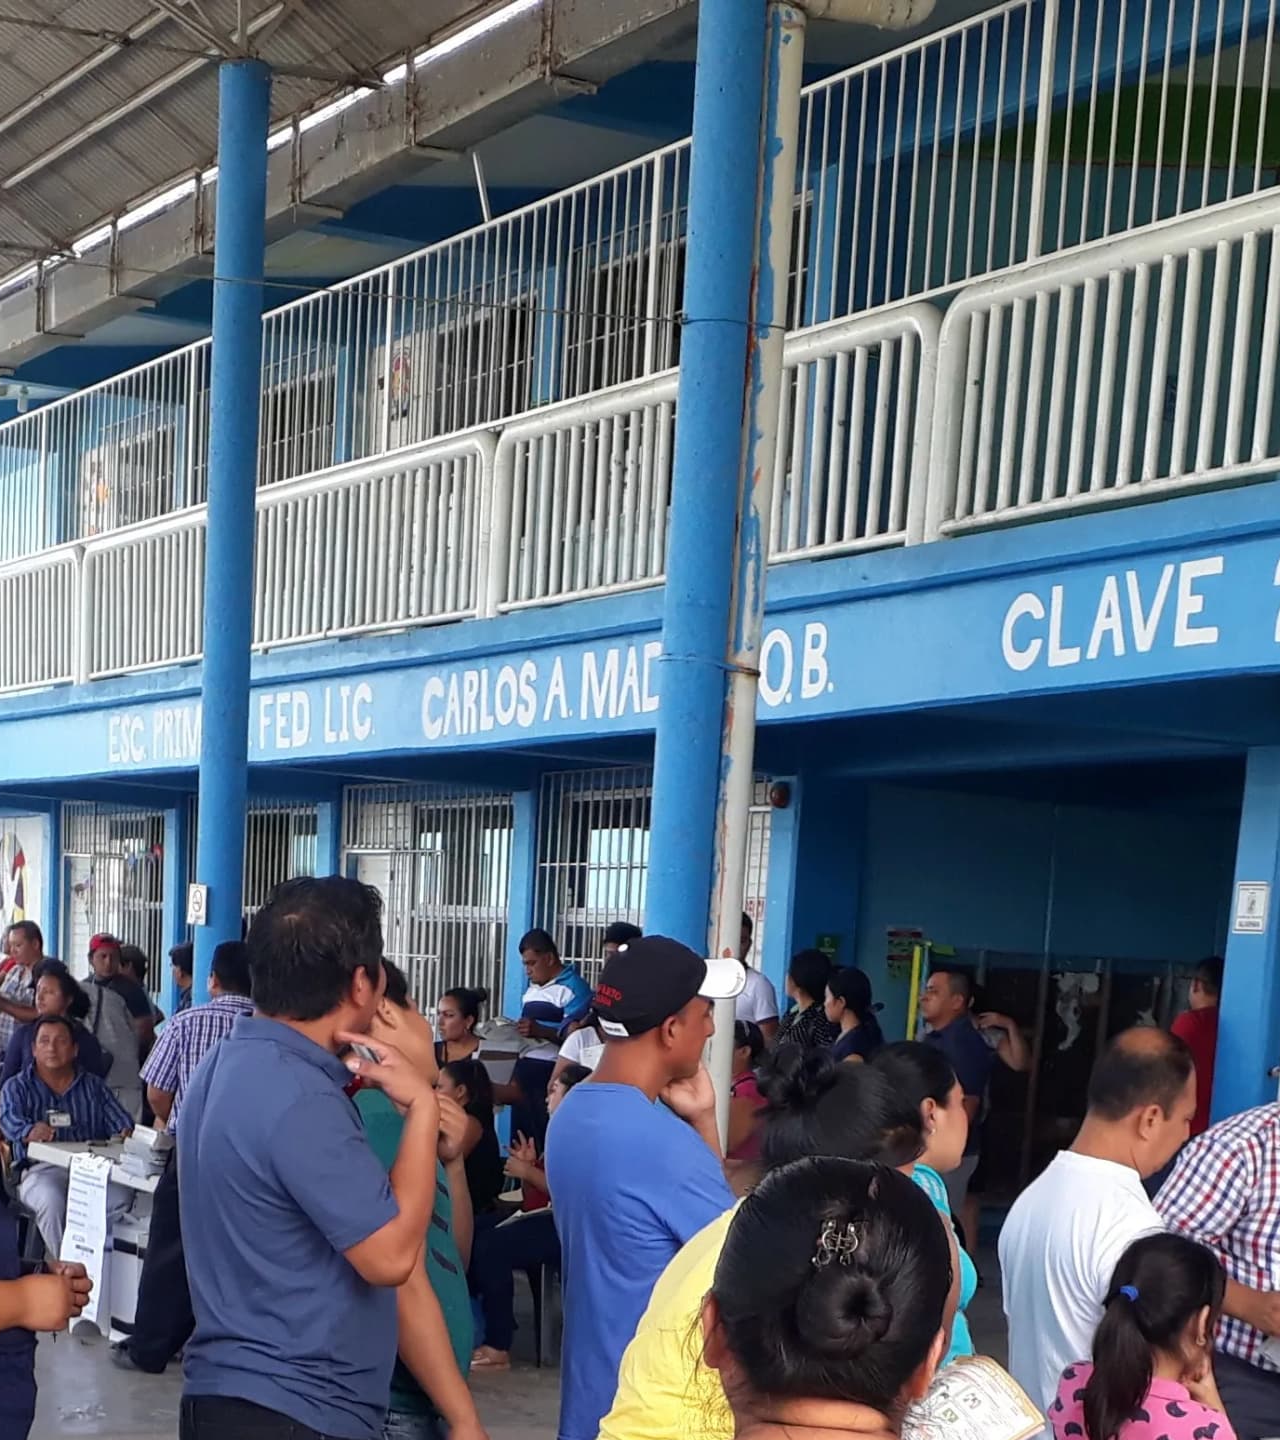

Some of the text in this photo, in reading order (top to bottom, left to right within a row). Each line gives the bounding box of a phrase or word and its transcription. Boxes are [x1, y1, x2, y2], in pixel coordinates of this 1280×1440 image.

[1002, 556, 1224, 672] CLAVE
[109, 714, 147, 764] ESC.
[259, 690, 312, 750] FED.
[324, 682, 376, 744] LIC.
[422, 658, 538, 740] CARLOS
[544, 655, 573, 721] A.
[802, 622, 834, 699] B.
